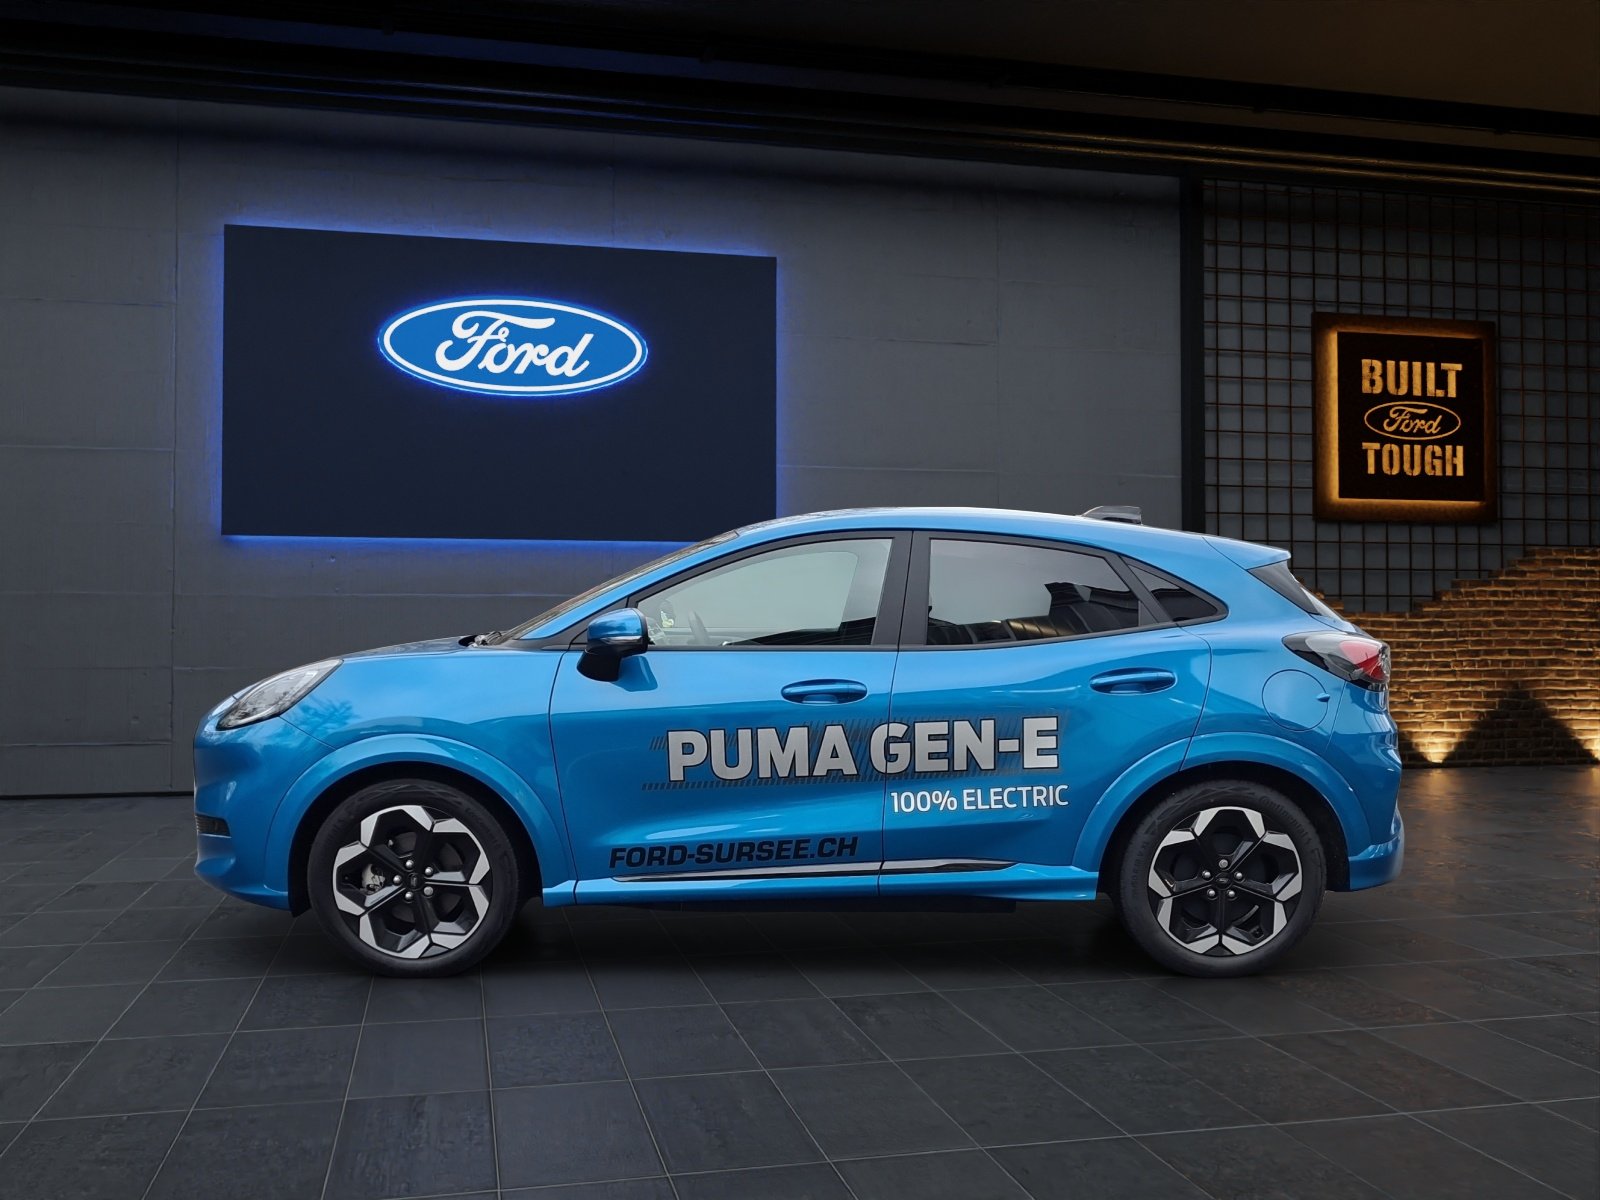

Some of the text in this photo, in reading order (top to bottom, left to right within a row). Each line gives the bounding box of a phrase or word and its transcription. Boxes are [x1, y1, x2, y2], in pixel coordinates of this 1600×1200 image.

[435, 310, 594, 377] Ford
[1361, 359, 1463, 398] BUILT
[1383, 405, 1442, 434] Ford
[1361, 442, 1465, 477] TOUGH
[666, 716, 1060, 783] PUMA GEN-E
[890, 784, 1069, 814] 100% ELECTRIC
[608, 836, 859, 869] FORD-SURSEE.CH
